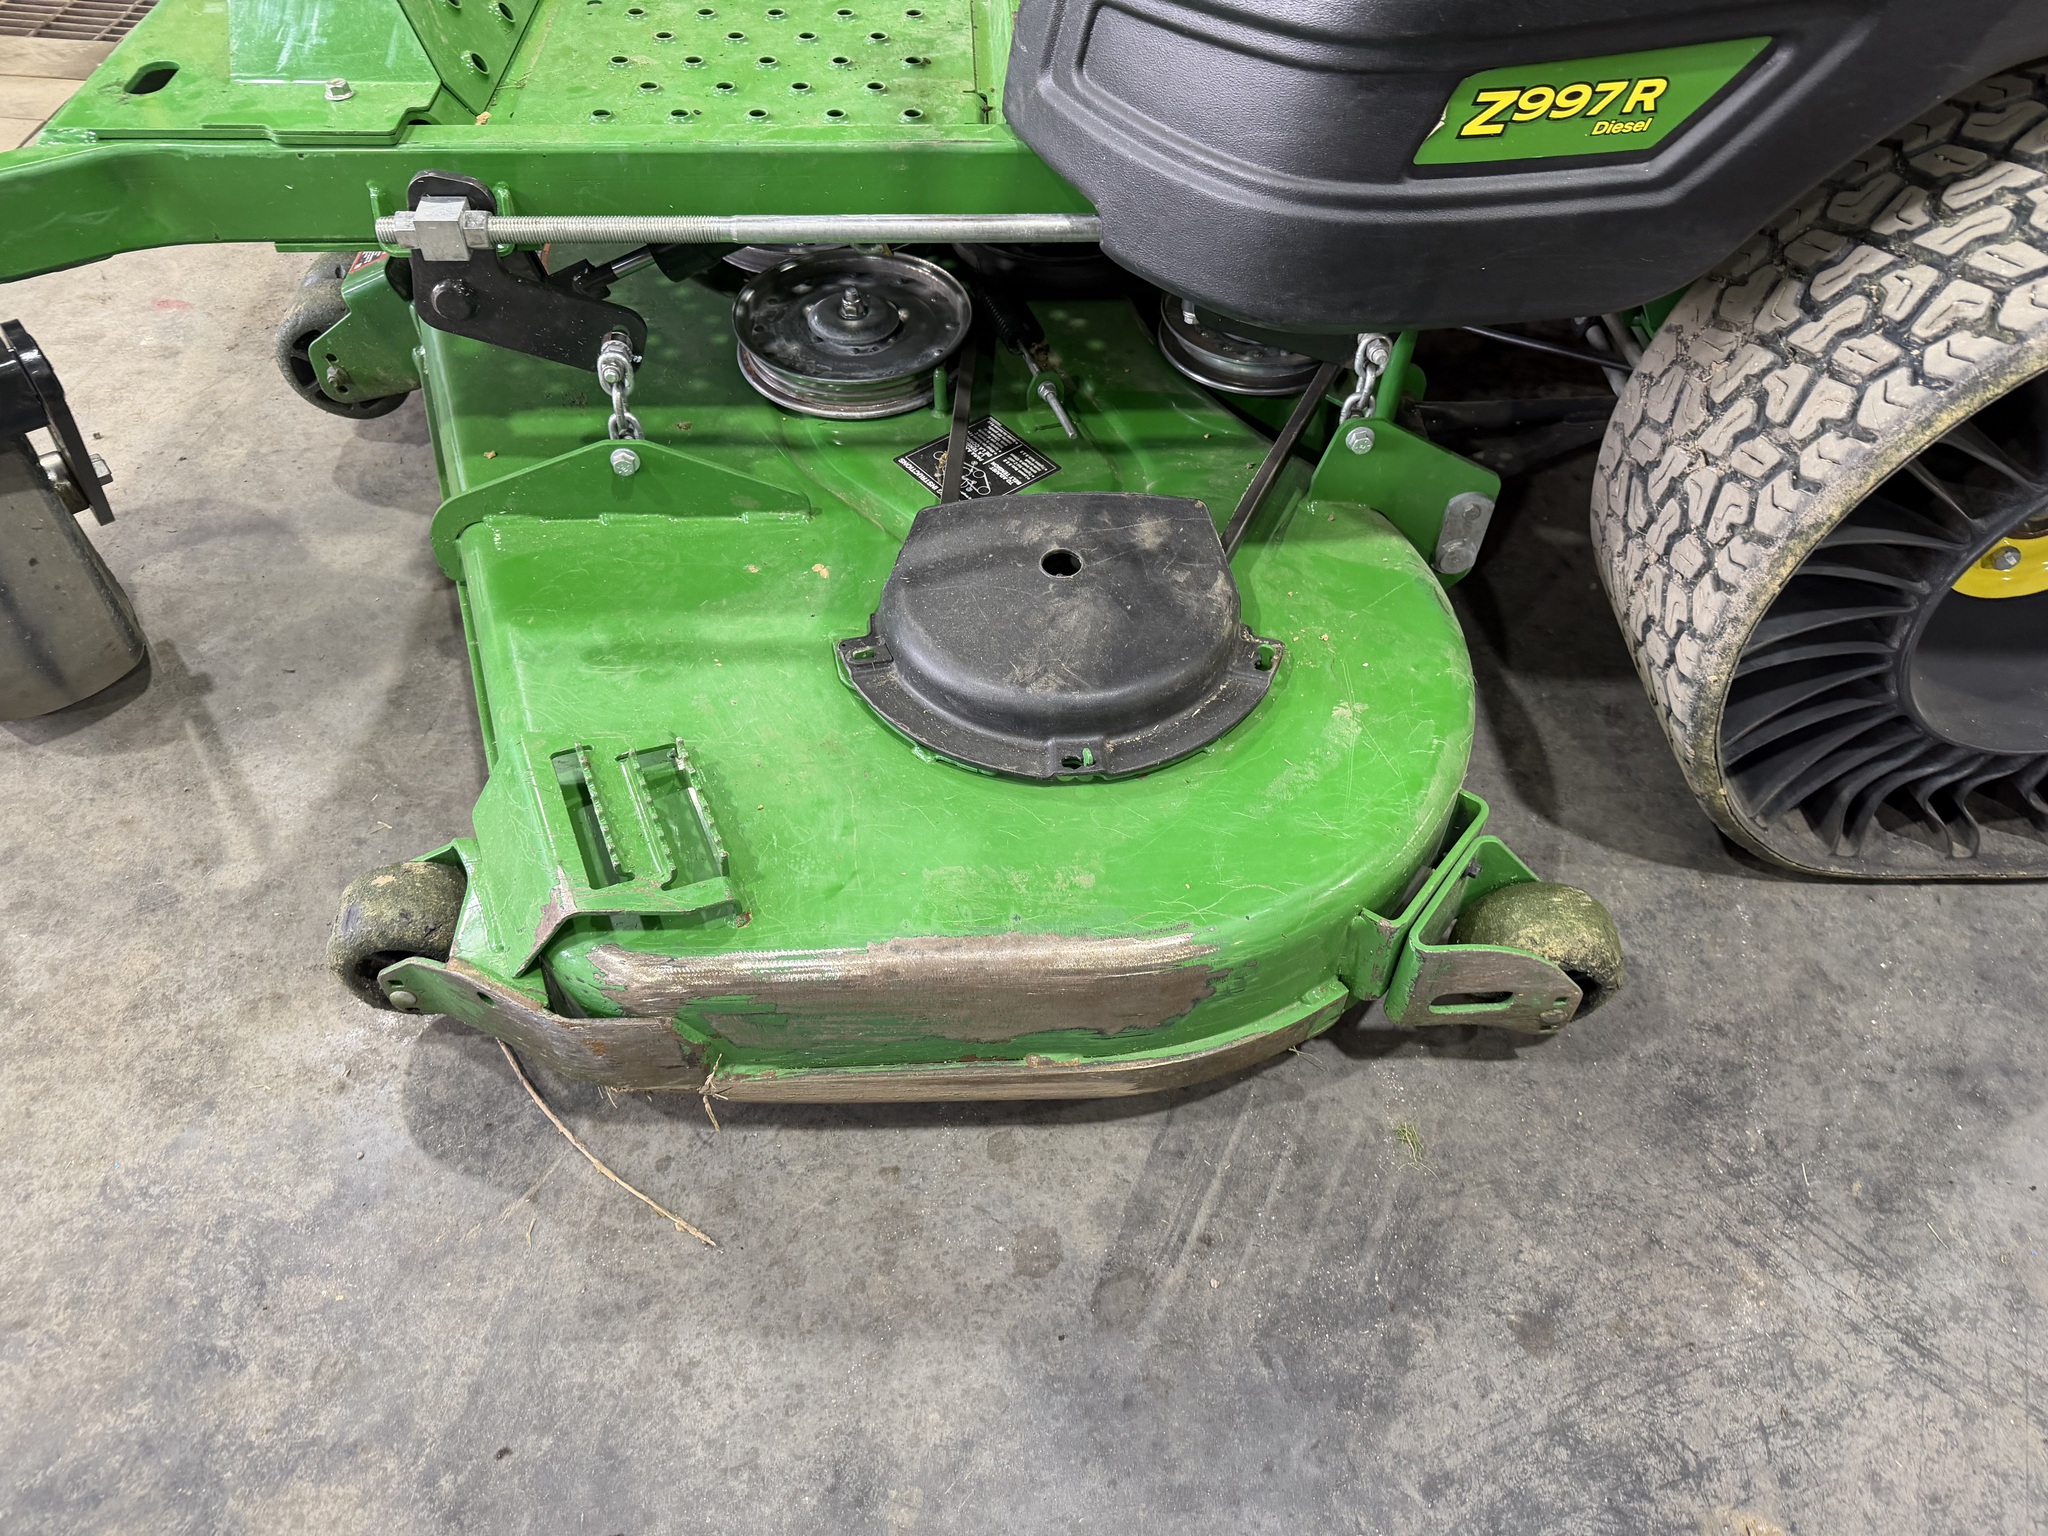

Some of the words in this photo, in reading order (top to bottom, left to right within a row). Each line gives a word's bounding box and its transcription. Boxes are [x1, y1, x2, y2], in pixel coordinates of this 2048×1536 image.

[1458, 77, 1669, 138] Z997R
[1591, 117, 1653, 136] Diesel
[898, 457, 940, 490] INSTRUCTIONS
